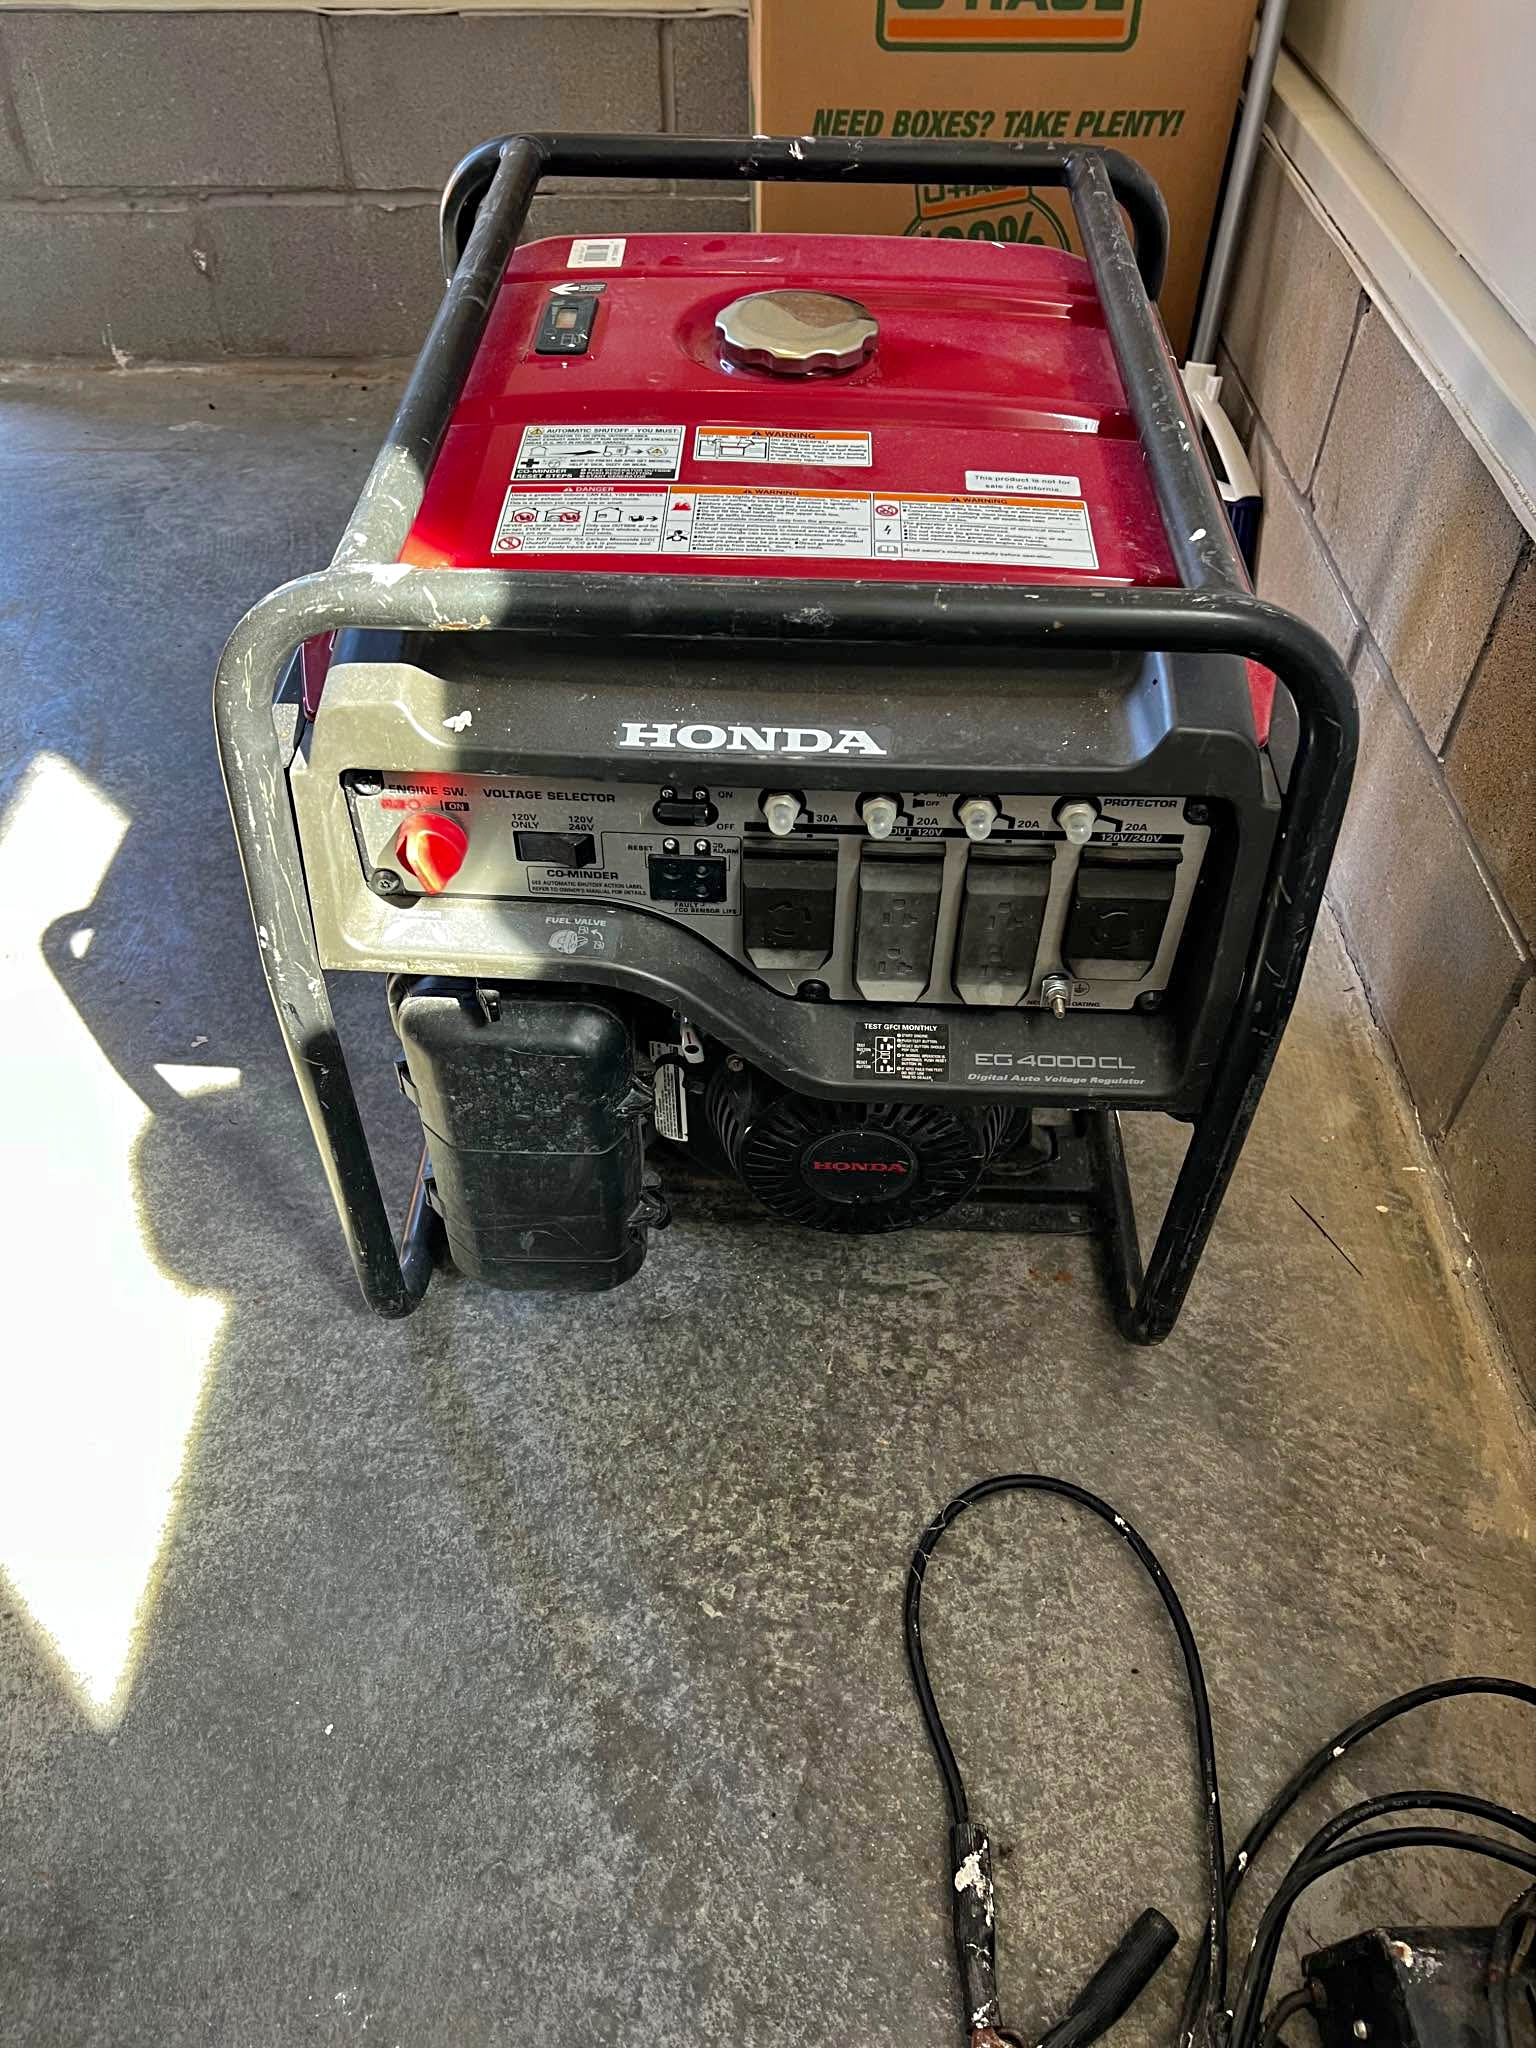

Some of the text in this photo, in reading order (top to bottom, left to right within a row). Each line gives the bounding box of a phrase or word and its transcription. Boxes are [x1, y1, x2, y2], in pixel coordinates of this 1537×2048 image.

[812, 108, 1186, 138] NEED BOXES? TAKE PLENTY!
[765, 431, 815, 439] WARNING
[975, 474, 993, 482] This
[994, 475, 1028, 484] product
[1057, 478, 1070, 486] for
[619, 722, 887, 755] HONDA
[388, 785, 467, 797] ENGINE SW.
[483, 789, 616, 803] VOLTAGE SELECTOR
[449, 802, 464, 810] ON
[1104, 798, 1178, 808] PROTECTOR
[511, 813, 537, 821] 120V
[568, 816, 593, 824] 120V
[816, 814, 838, 823] 30A
[916, 817, 939, 826] 20A
[511, 821, 539, 829] ONLY
[568, 823, 594, 831] 240V
[716, 823, 735, 831] OFF
[1017, 820, 1040, 828] 20A
[1125, 823, 1147, 831] 20A
[918, 828, 943, 837] 120V
[1101, 833, 1162, 842] 120V/240V
[547, 869, 619, 880] CO-MINDER
[545, 916, 607, 927] FUEL VALVE
[901, 1024, 937, 1032] MONTHLY
[968, 1073, 1146, 1086] Digital Auto Voltage Regulator
[814, 1161, 907, 1173] HONDA
